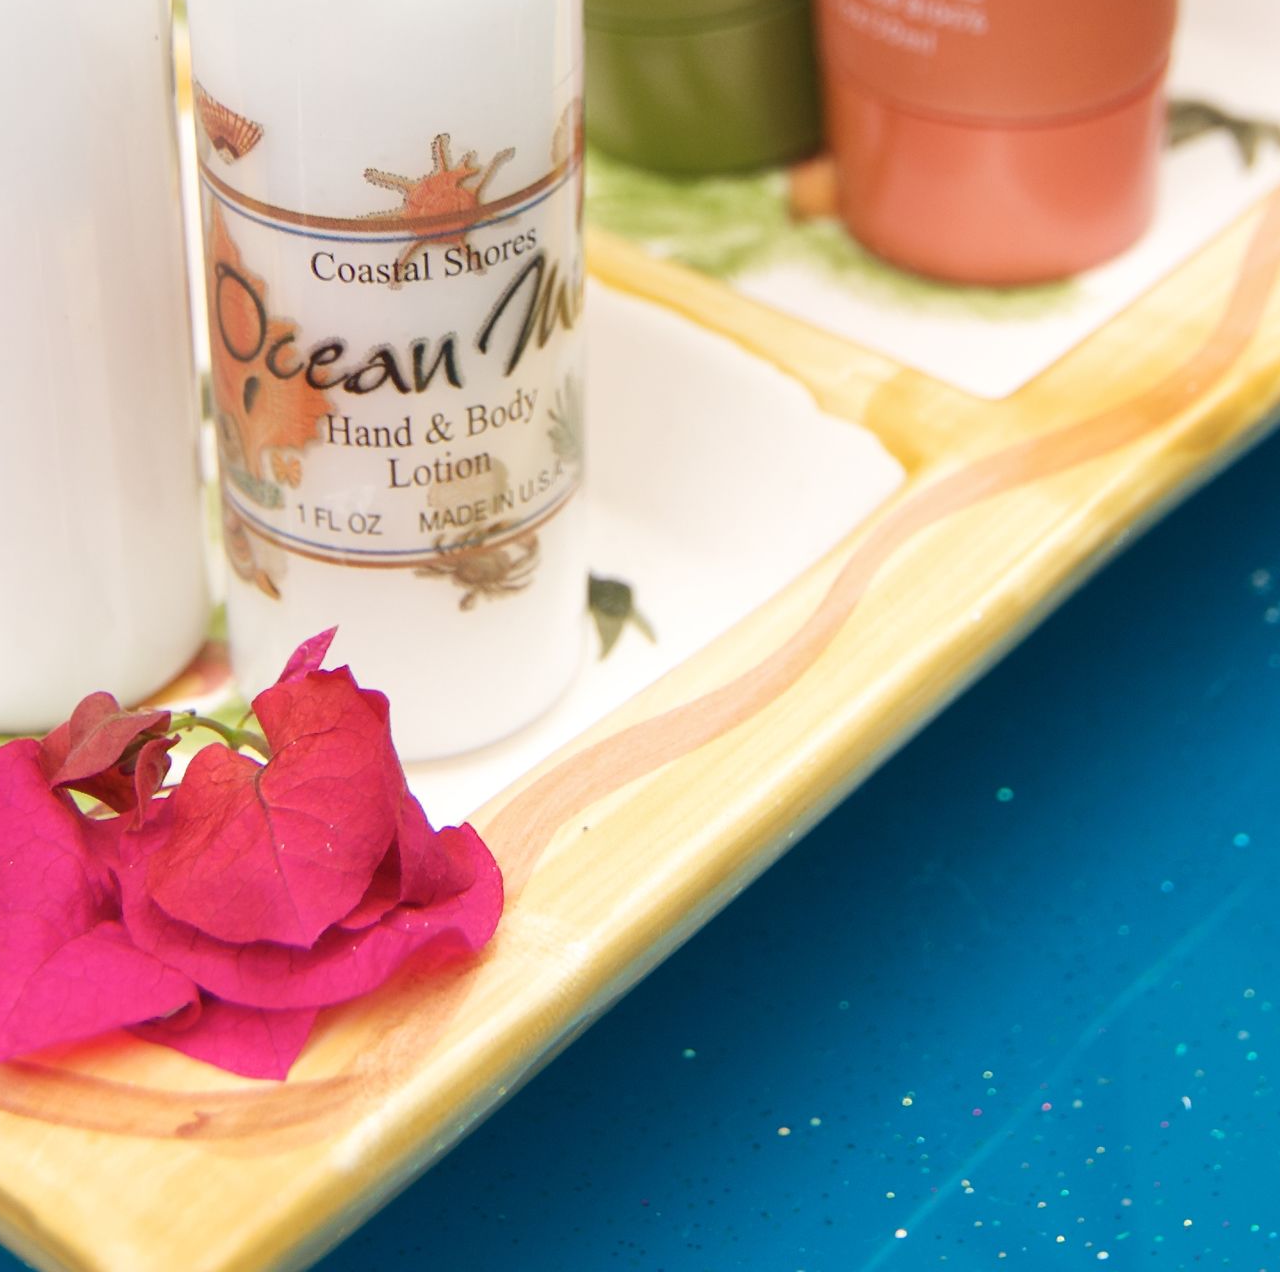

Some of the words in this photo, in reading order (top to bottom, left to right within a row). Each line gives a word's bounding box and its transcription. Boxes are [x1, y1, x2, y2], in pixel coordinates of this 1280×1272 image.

[310, 250, 433, 286] Coastal
[443, 227, 539, 278] Shores
[214, 260, 466, 396] Ocean
[326, 414, 412, 449] Hand
[426, 412, 455, 447] &
[466, 387, 539, 441] Body
[388, 450, 493, 490] Lotion
[296, 503, 307, 524] 1
[314, 507, 342, 533] FL
[347, 512, 384, 536] OZ
[419, 500, 487, 534] MADE
[491, 492, 515, 517] IN
